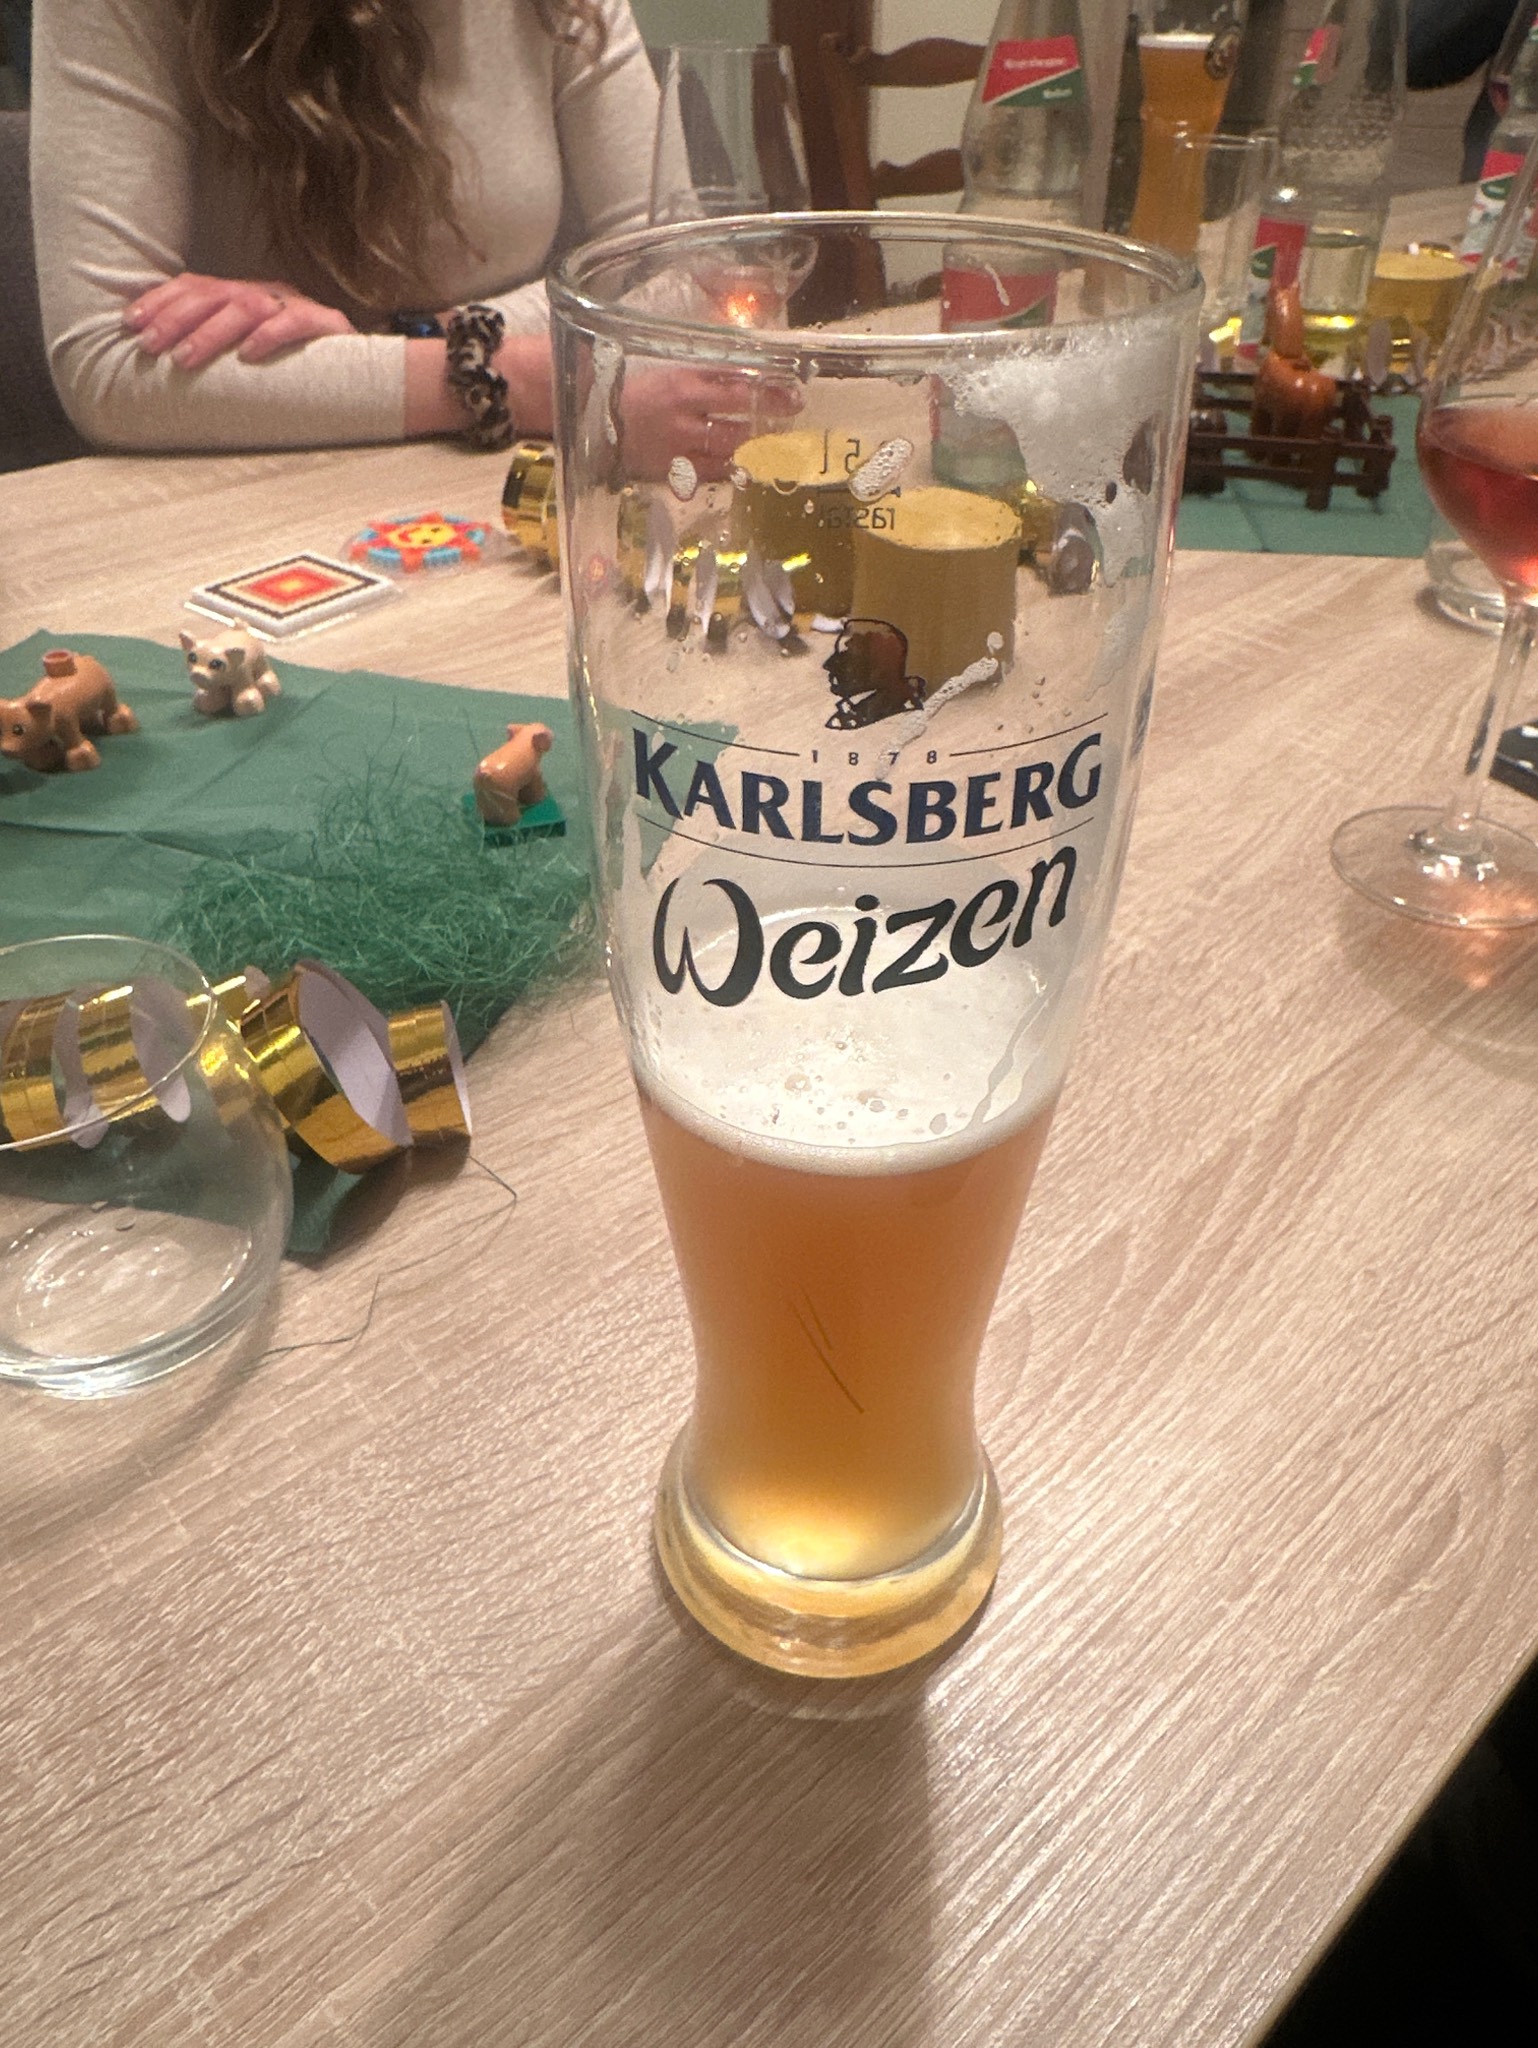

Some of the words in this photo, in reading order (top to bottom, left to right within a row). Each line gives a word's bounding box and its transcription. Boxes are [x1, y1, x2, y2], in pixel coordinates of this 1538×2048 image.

[632, 729, 1102, 847] KARLSBERG
[811, 750, 938, 766] 1878
[652, 846, 1077, 1007] Weizen
